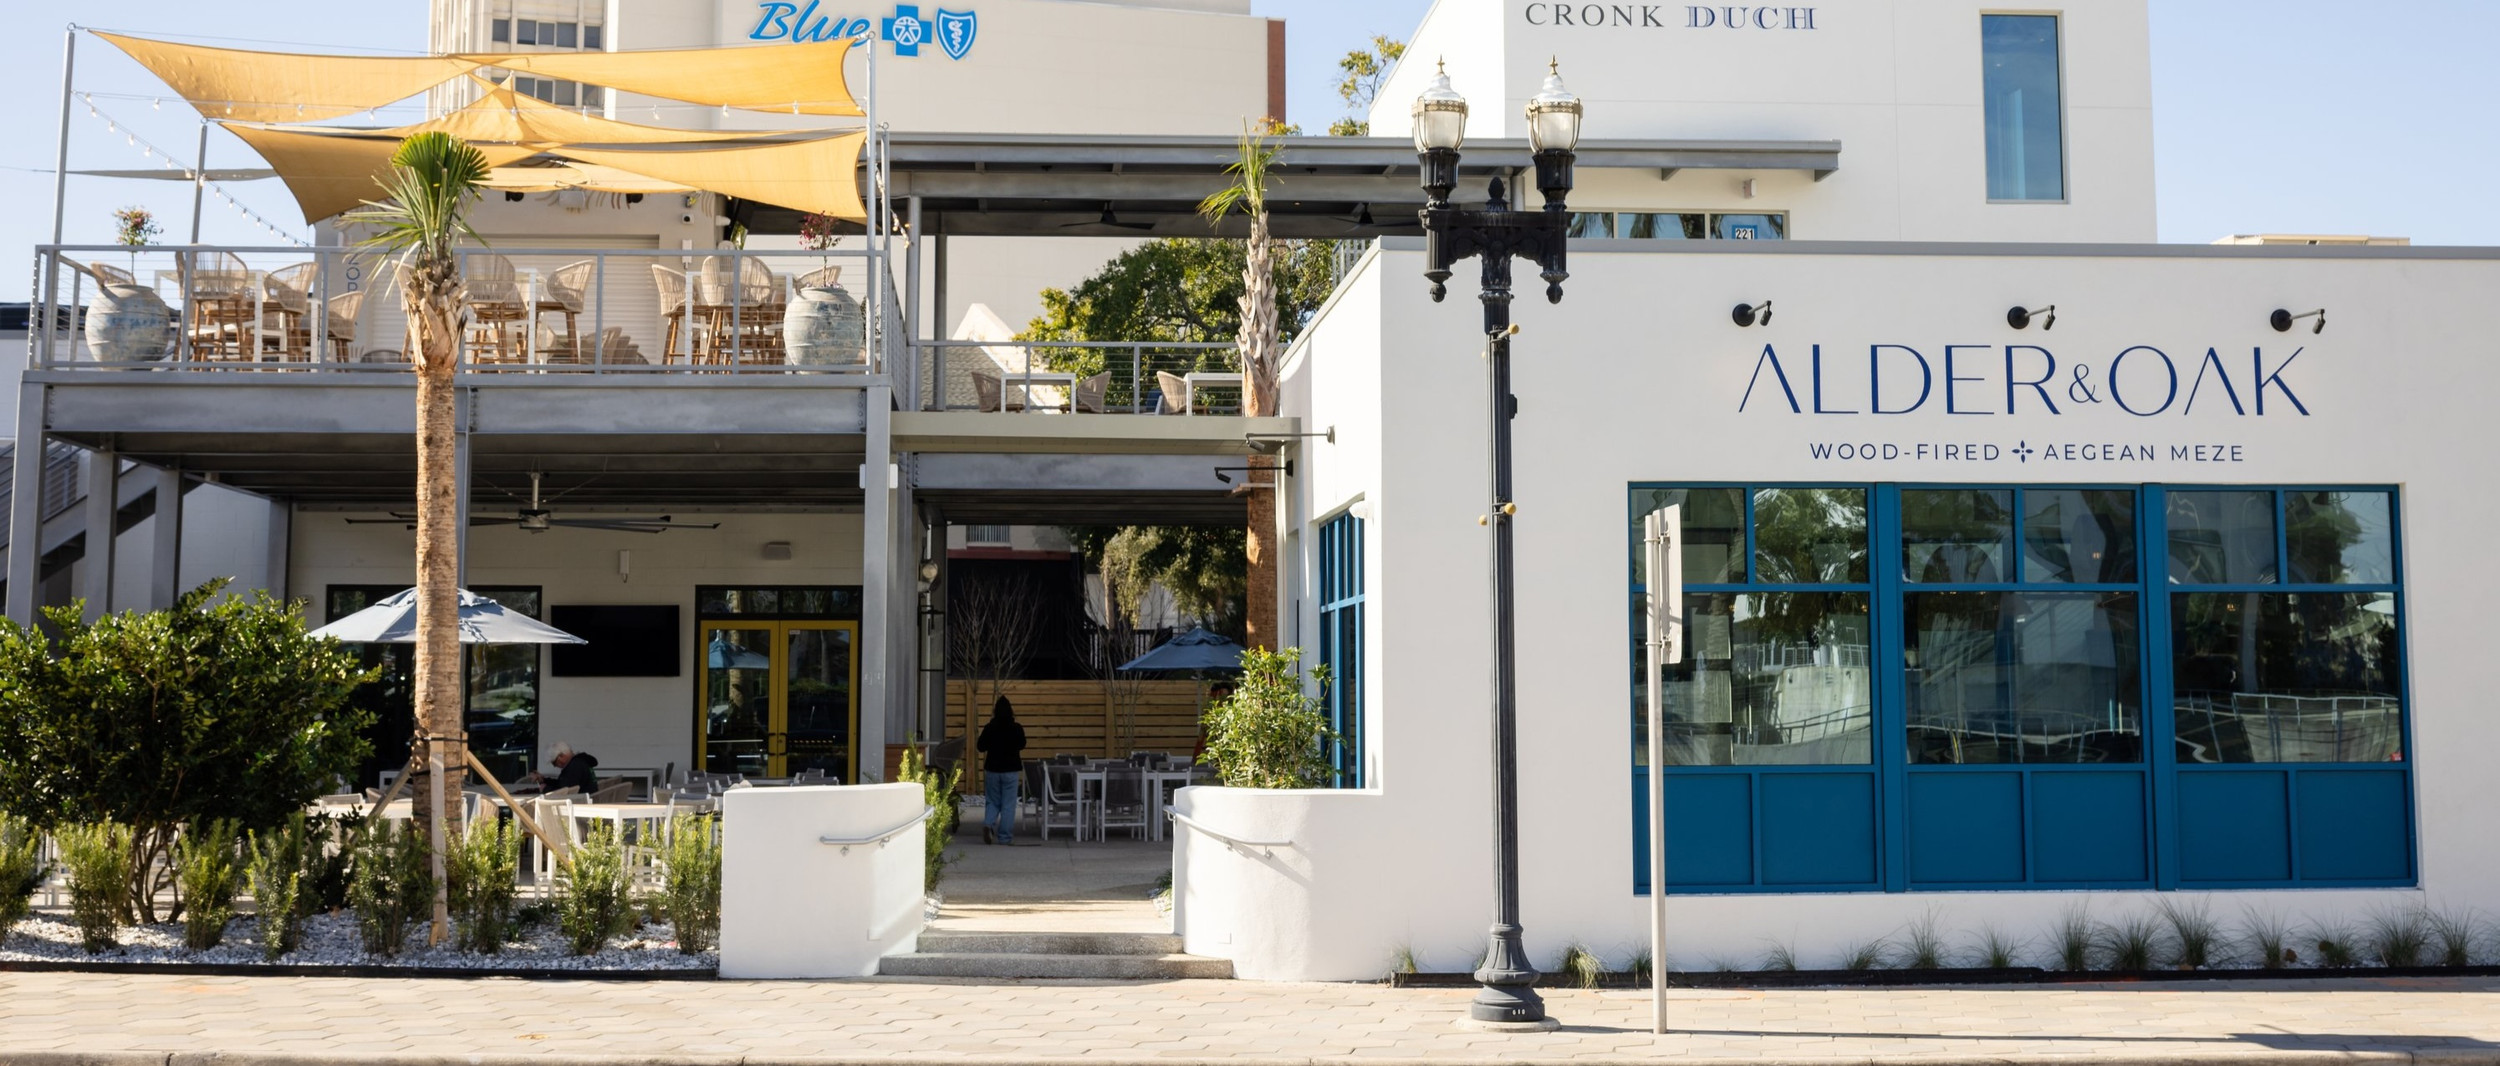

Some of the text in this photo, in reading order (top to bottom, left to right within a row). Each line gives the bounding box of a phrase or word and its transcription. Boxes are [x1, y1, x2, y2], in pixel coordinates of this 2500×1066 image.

[749, 0, 871, 47] Blue
[1525, 2, 1818, 30] CRONK DUCH
[1735, 228, 1754, 240] 221
[1809, 442, 2244, 462] WOOD-FIRED AEGEAN MEZE
